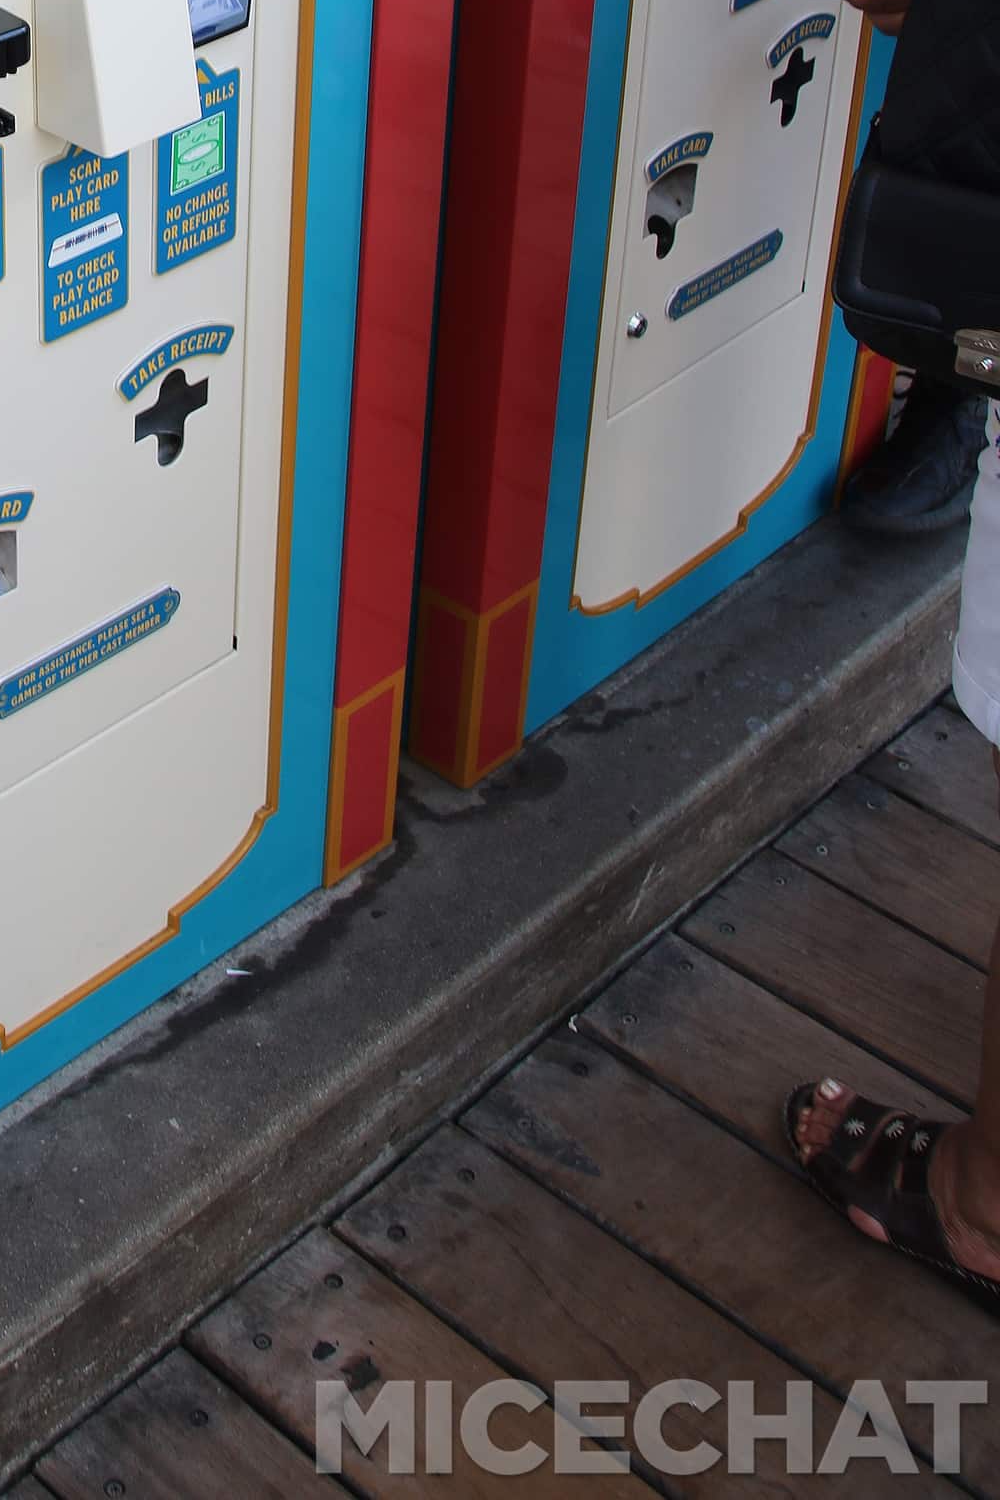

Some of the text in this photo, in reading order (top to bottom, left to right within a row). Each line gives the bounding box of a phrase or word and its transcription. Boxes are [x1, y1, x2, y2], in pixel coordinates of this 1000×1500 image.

[774, 19, 832, 59] TAKE RECEIPT
[205, 81, 235, 108] BILLS
[69, 159, 101, 184] SCAN
[654, 137, 707, 174] TAKE CARD
[51, 169, 119, 212] PLAY CARD
[70, 196, 101, 223] HERE
[166, 182, 228, 222] NO CHANGE
[163, 198, 230, 244] OR REFUNDS
[167, 222, 226, 260] AVAILABLE
[52, 268, 120, 311] PLAY CARD
[56, 250, 116, 289] TO CHECK
[59, 289, 113, 325] BALANCE
[129, 330, 226, 391] TAKE RECEIPT
[11, 613, 161, 707] GAMES OF THE PIER CAST MEMBER
[18, 603, 155, 690] FOR ASSISTANCE, PLEASE SEE A
